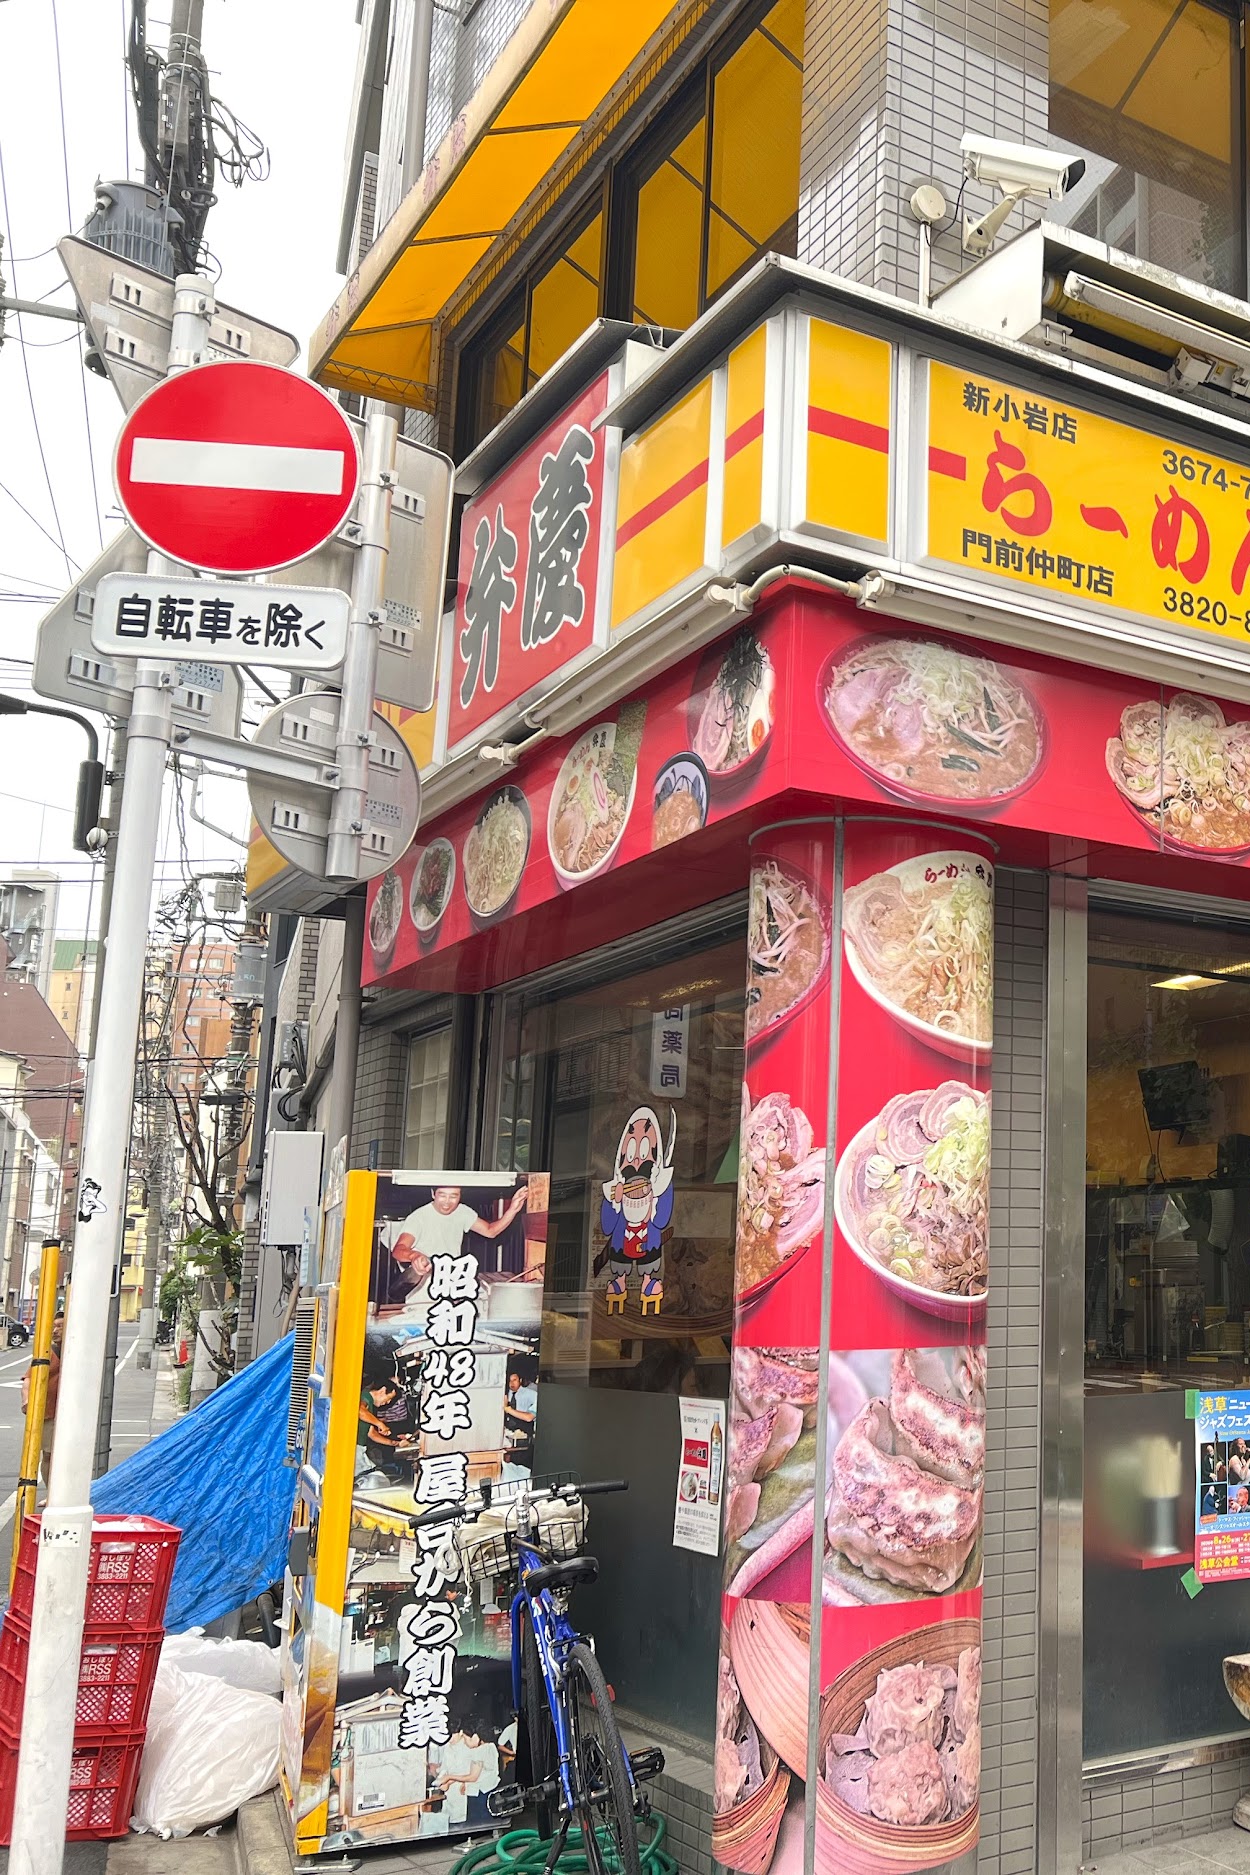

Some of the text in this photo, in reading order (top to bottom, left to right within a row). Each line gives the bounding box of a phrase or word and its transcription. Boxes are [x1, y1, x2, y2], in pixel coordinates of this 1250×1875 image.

[962, 381, 1078, 445] 新小岩店
[458, 422, 594, 709] 弁慶
[961, 527, 1115, 599] 門前仲町店
[114, 592, 327, 651] 自転車を除く
[100, 1554, 132, 1562] おしぼり
[82, 1656, 114, 1664] おしぼり
